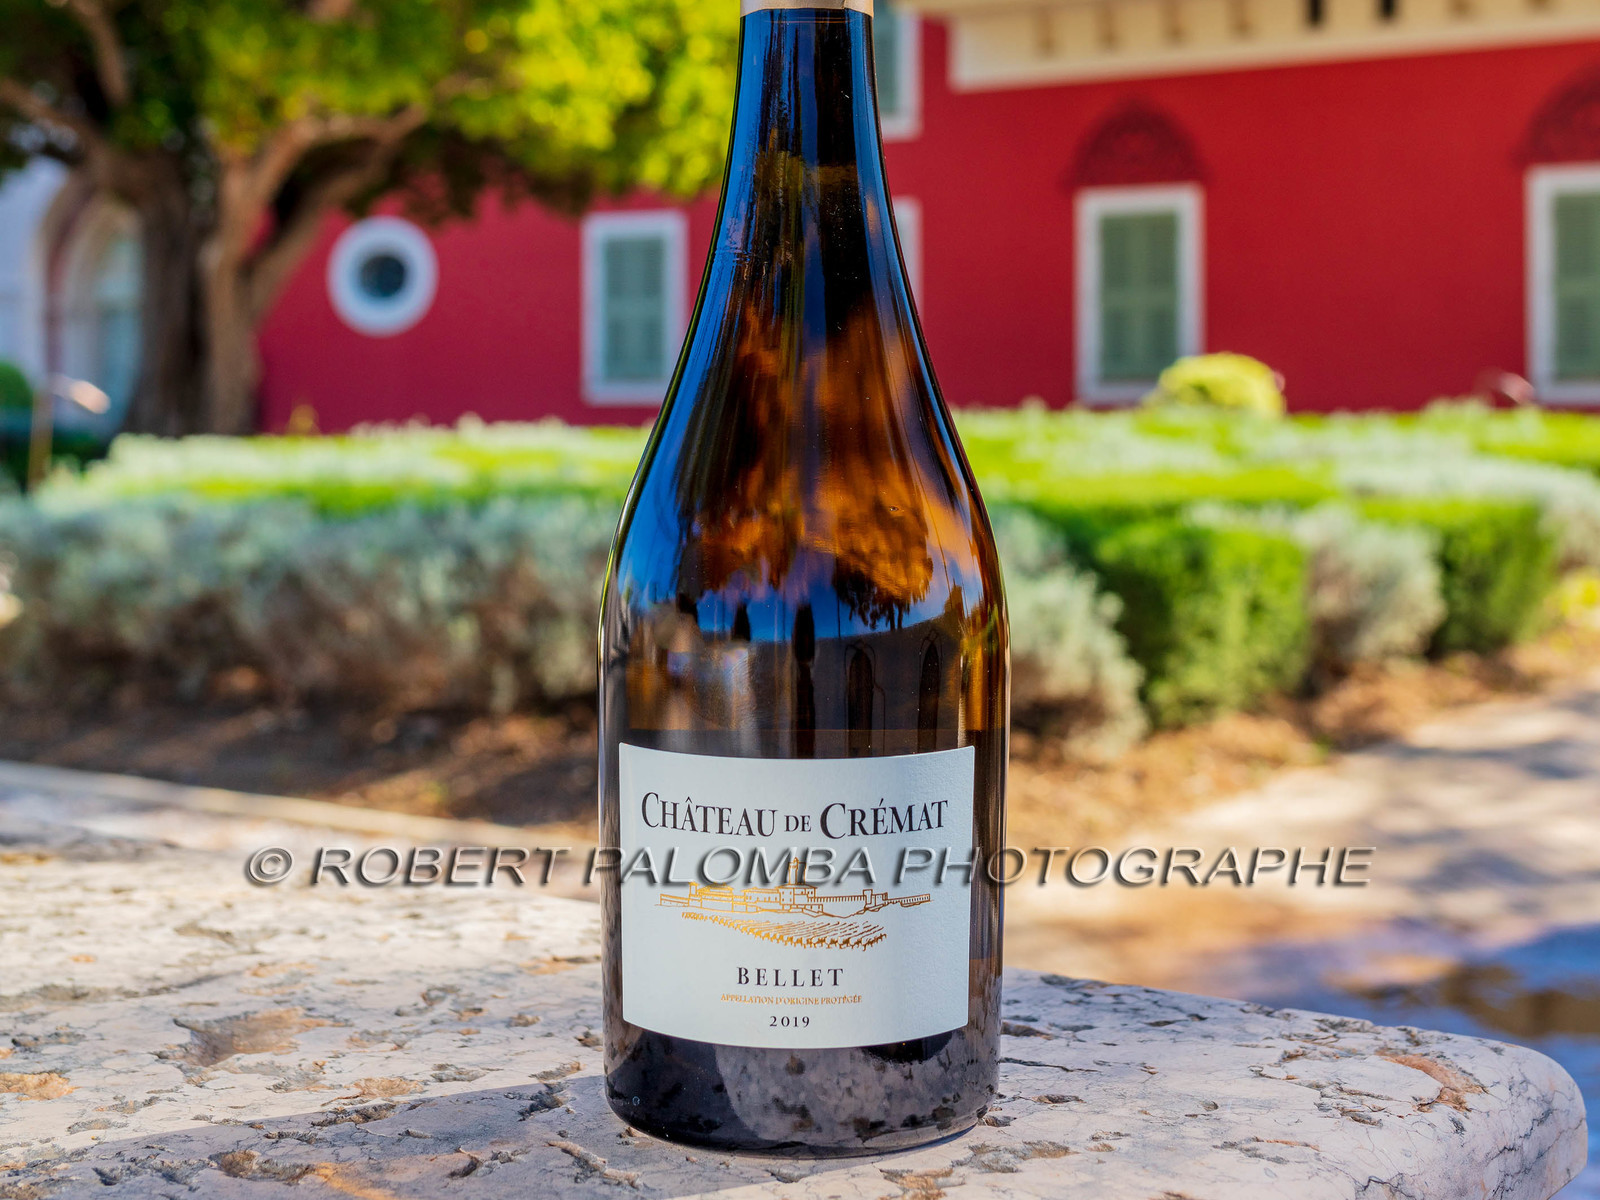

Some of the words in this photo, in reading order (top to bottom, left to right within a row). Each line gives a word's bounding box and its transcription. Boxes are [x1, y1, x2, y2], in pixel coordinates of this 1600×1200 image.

[641, 791, 778, 837] CHÂTEAU
[784, 814, 811, 833] DE
[820, 797, 949, 840] CRÉMAT
[736, 966, 844, 988] BELLET
[720, 993, 774, 1005] APPELLATION
[769, 1015, 811, 1028] 2019
